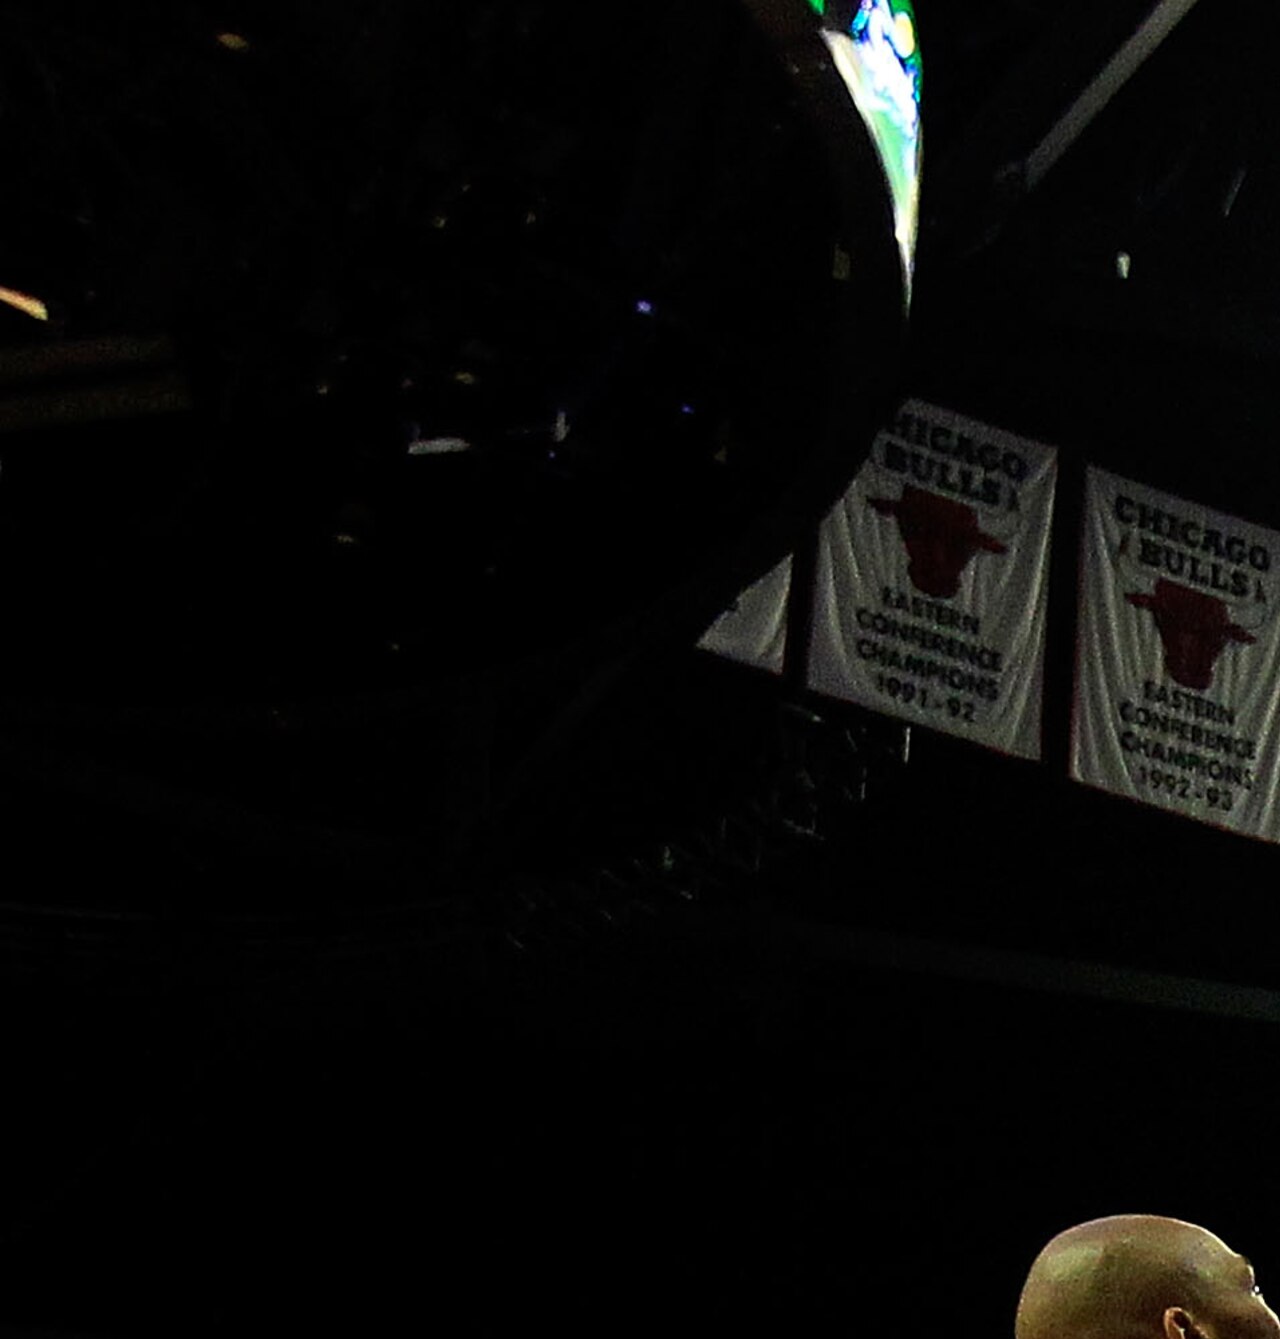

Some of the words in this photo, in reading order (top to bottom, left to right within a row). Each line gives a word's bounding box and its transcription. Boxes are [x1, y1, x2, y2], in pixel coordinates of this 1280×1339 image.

[885, 441, 1001, 505] BULLS
[1116, 495, 1269, 571] CHICAGO
[1140, 538, 1247, 596] BULLS
[884, 586, 979, 634] EASTERN
[856, 609, 1002, 673] CONFERENCE
[857, 639, 998, 701] CHAMPIONS
[1120, 702, 1256, 760] CONFERENCE
[1144, 681, 1234, 725] EASTERN
[1120, 731, 1252, 790] CHAMPIONS
